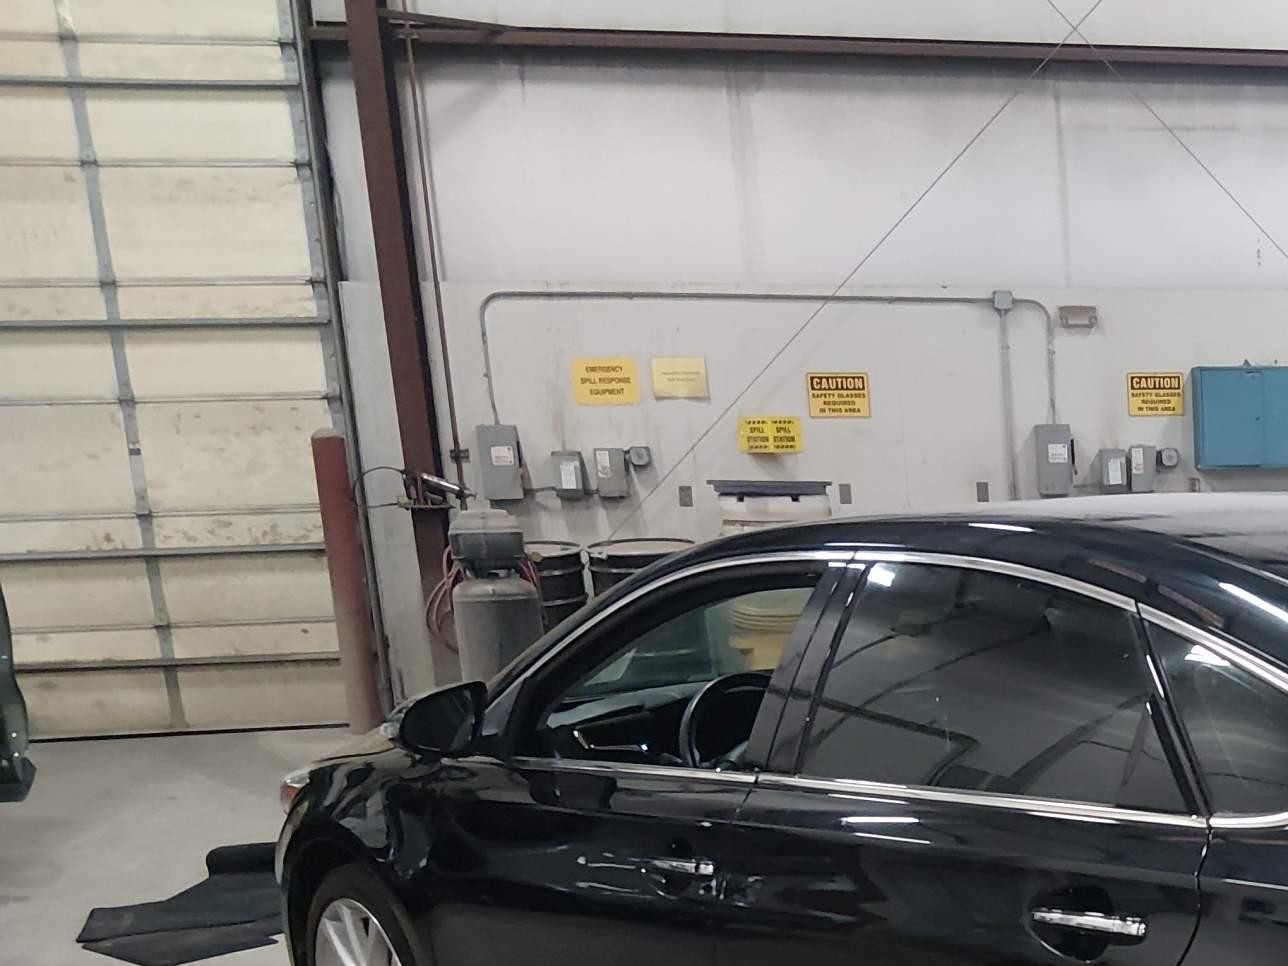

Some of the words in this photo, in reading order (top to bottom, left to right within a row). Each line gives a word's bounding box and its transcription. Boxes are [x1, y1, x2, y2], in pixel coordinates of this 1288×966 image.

[812, 378, 863, 389] CAUTION
[1132, 378, 1179, 389] CAUTION
[776, 426, 792, 434] SPILL
